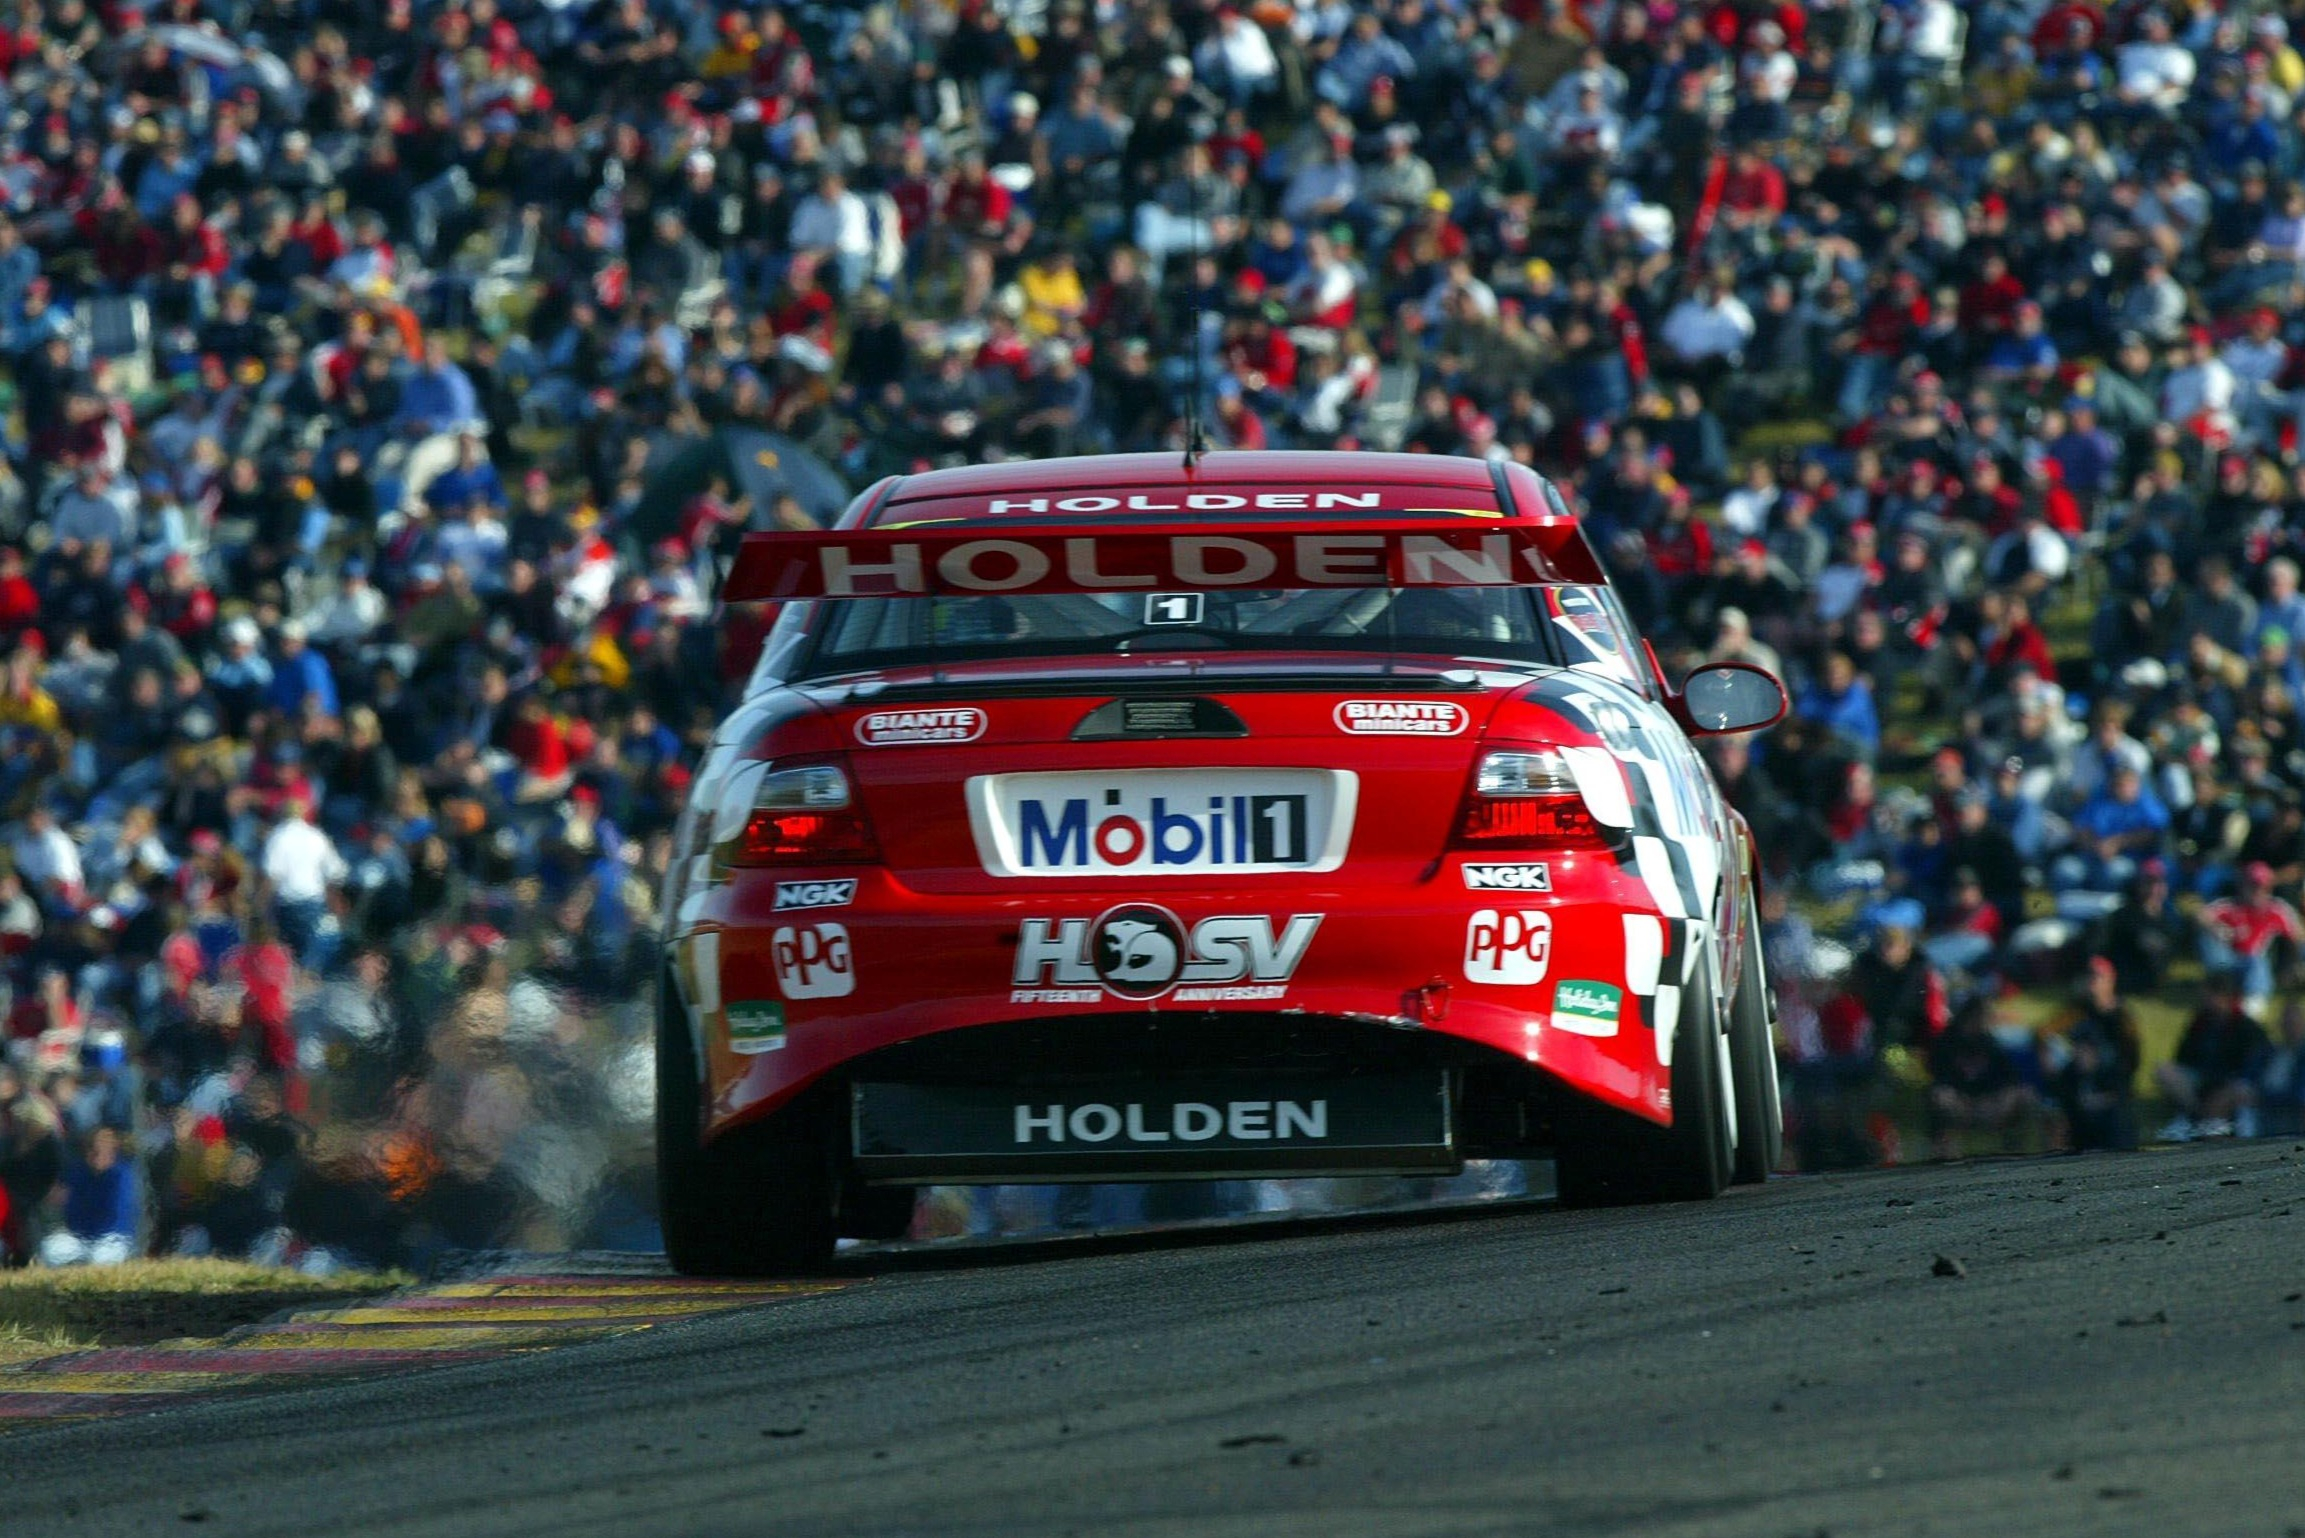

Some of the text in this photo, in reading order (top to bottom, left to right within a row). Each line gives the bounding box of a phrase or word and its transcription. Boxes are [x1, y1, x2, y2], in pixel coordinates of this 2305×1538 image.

[989, 493, 1380, 513] HOLDEN
[819, 535, 1513, 595] HOLDEN
[1157, 597, 1189, 620] 1
[868, 711, 976, 730] BIANTE
[1346, 704, 1457, 719] BIANTE
[1352, 719, 1451, 731] minicars
[1019, 796, 1295, 867] Mobil 1
[1466, 866, 1547, 888] NGK
[775, 883, 850, 907] NGK
[1469, 912, 1552, 970] PPG
[777, 925, 848, 985] PPG
[1014, 1100, 1327, 1143] HOLDEN
